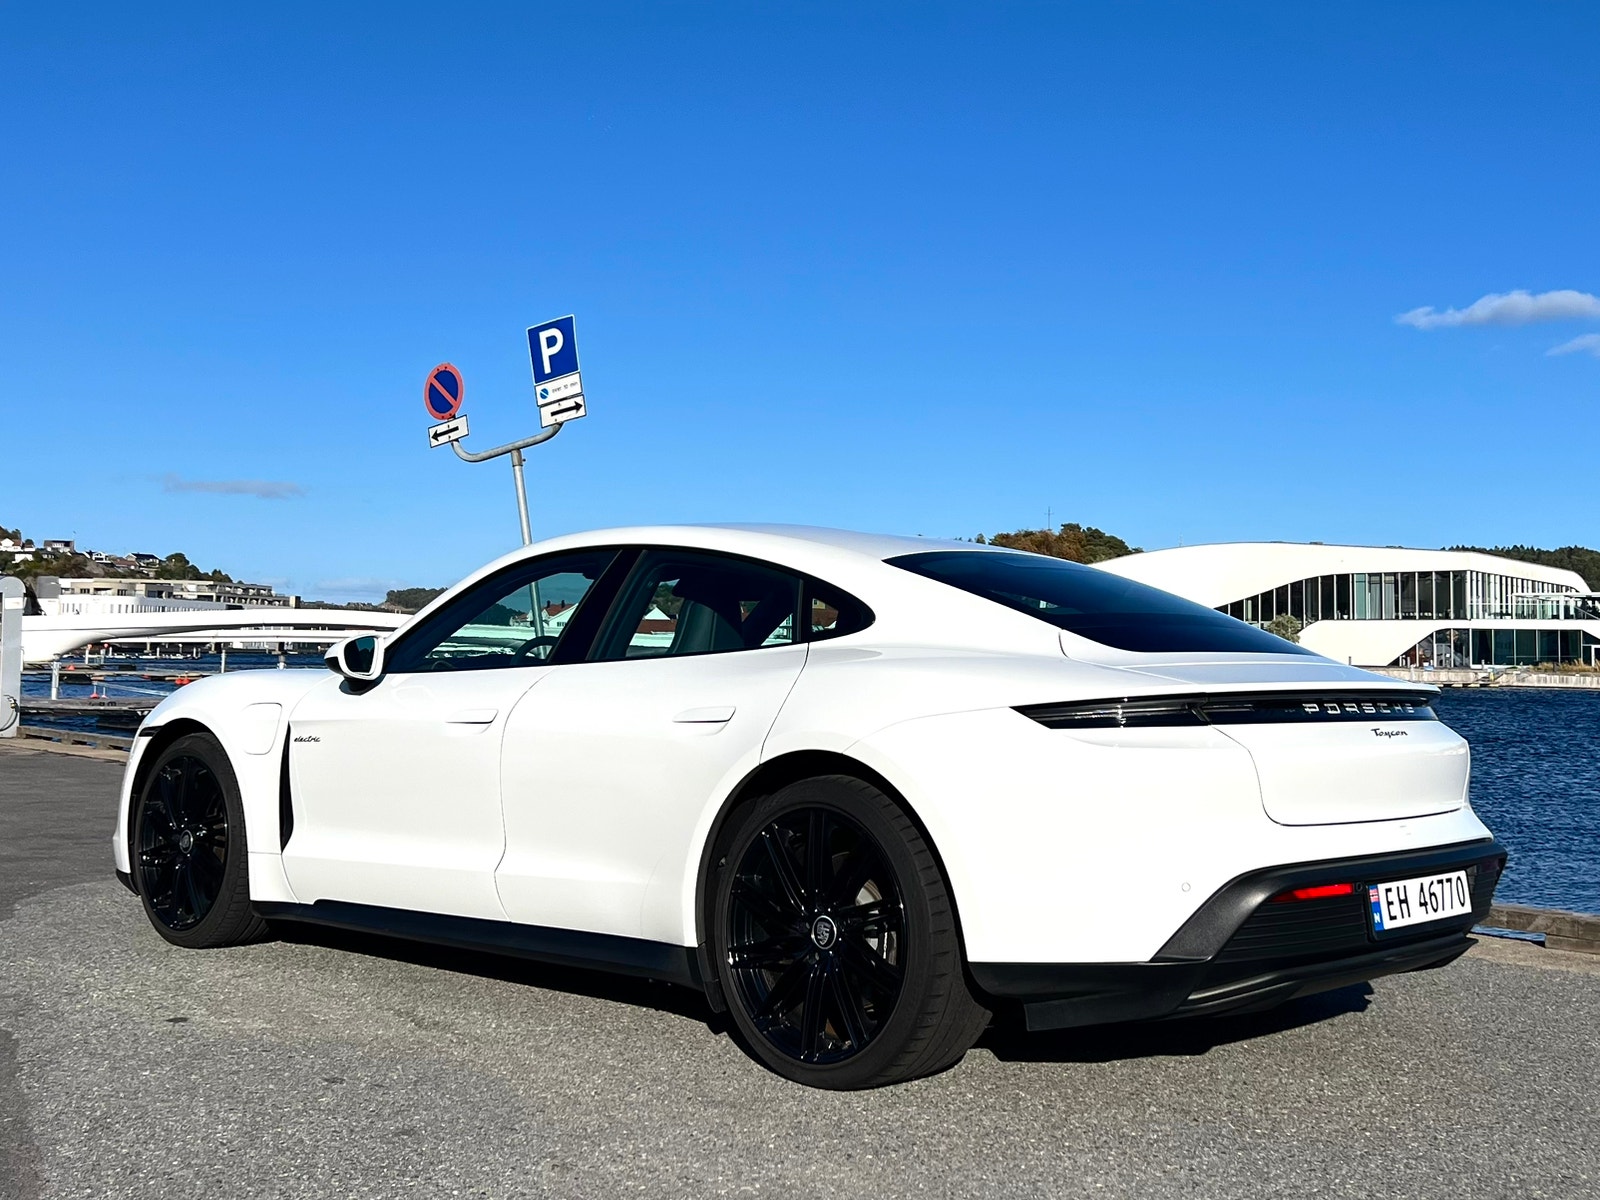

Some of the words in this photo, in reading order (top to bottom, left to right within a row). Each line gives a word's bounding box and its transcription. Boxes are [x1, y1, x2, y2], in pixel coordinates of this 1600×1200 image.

[538, 327, 564, 375] P
[1302, 703, 1415, 715] PORSCHE
[293, 735, 321, 743] electric
[1385, 885, 1411, 921] EH
[1419, 876, 1466, 914] 46770
[1373, 912, 1381, 924] N
